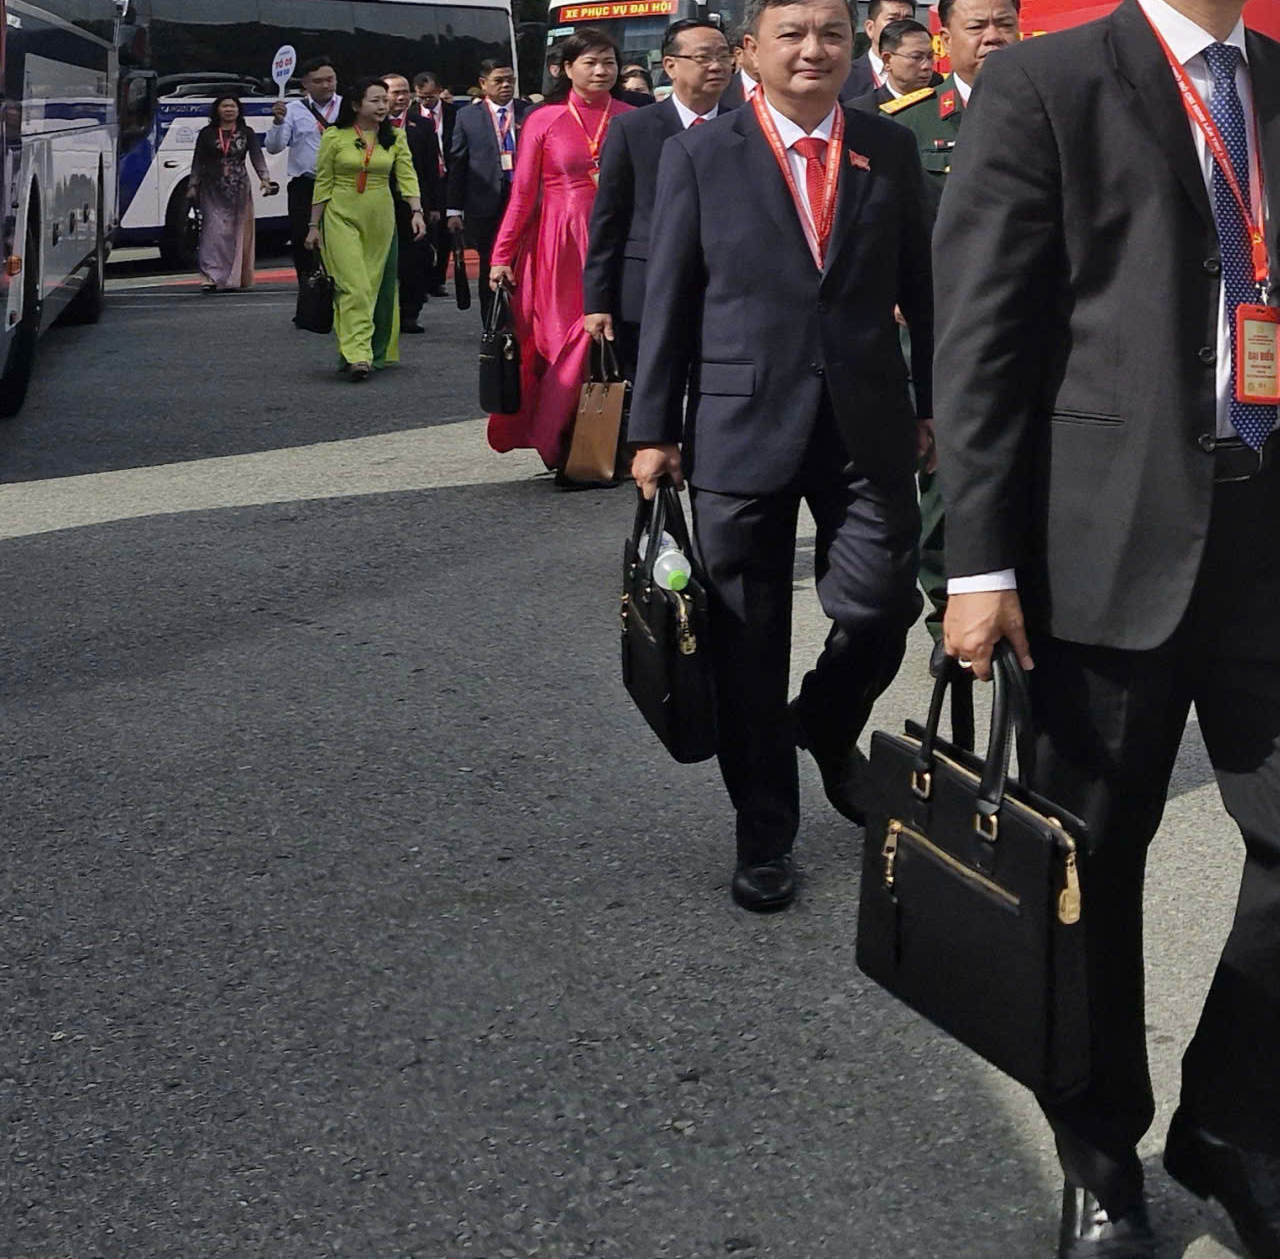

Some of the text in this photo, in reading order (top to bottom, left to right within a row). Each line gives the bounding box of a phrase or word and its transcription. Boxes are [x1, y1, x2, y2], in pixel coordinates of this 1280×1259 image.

[566, 1, 672, 18] XE PHỤC VỤ ĐẠI HỘI
